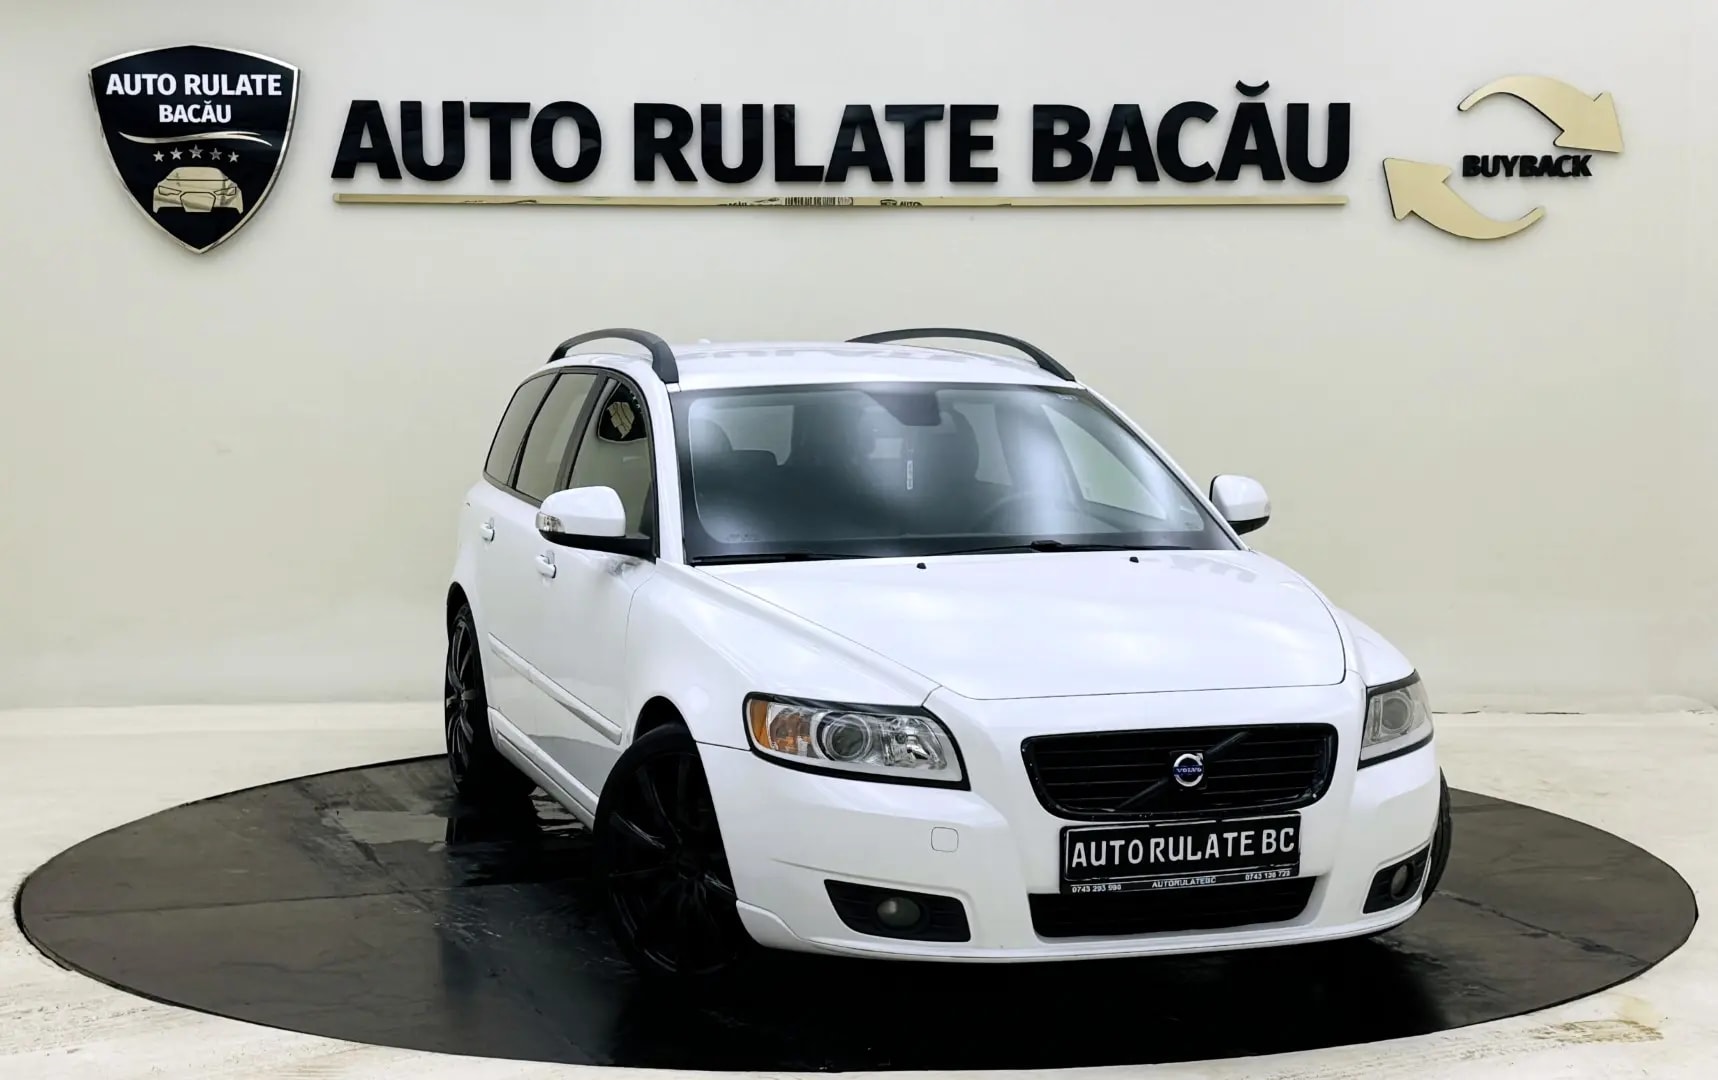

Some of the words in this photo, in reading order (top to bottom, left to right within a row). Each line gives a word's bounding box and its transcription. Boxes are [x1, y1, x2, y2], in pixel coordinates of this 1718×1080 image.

[106, 73, 177, 96] AUTO
[184, 74, 282, 96] RULATE
[158, 100, 232, 123] BACĂU
[331, 99, 602, 184] AUTO
[633, 103, 999, 184] RULATE
[1032, 79, 1351, 184] BACĂU
[1462, 154, 1593, 177] BUYBACK
[1071, 839, 1144, 868] AUTO
[1150, 830, 1255, 863] RULATE
[1261, 827, 1295, 855] BC
